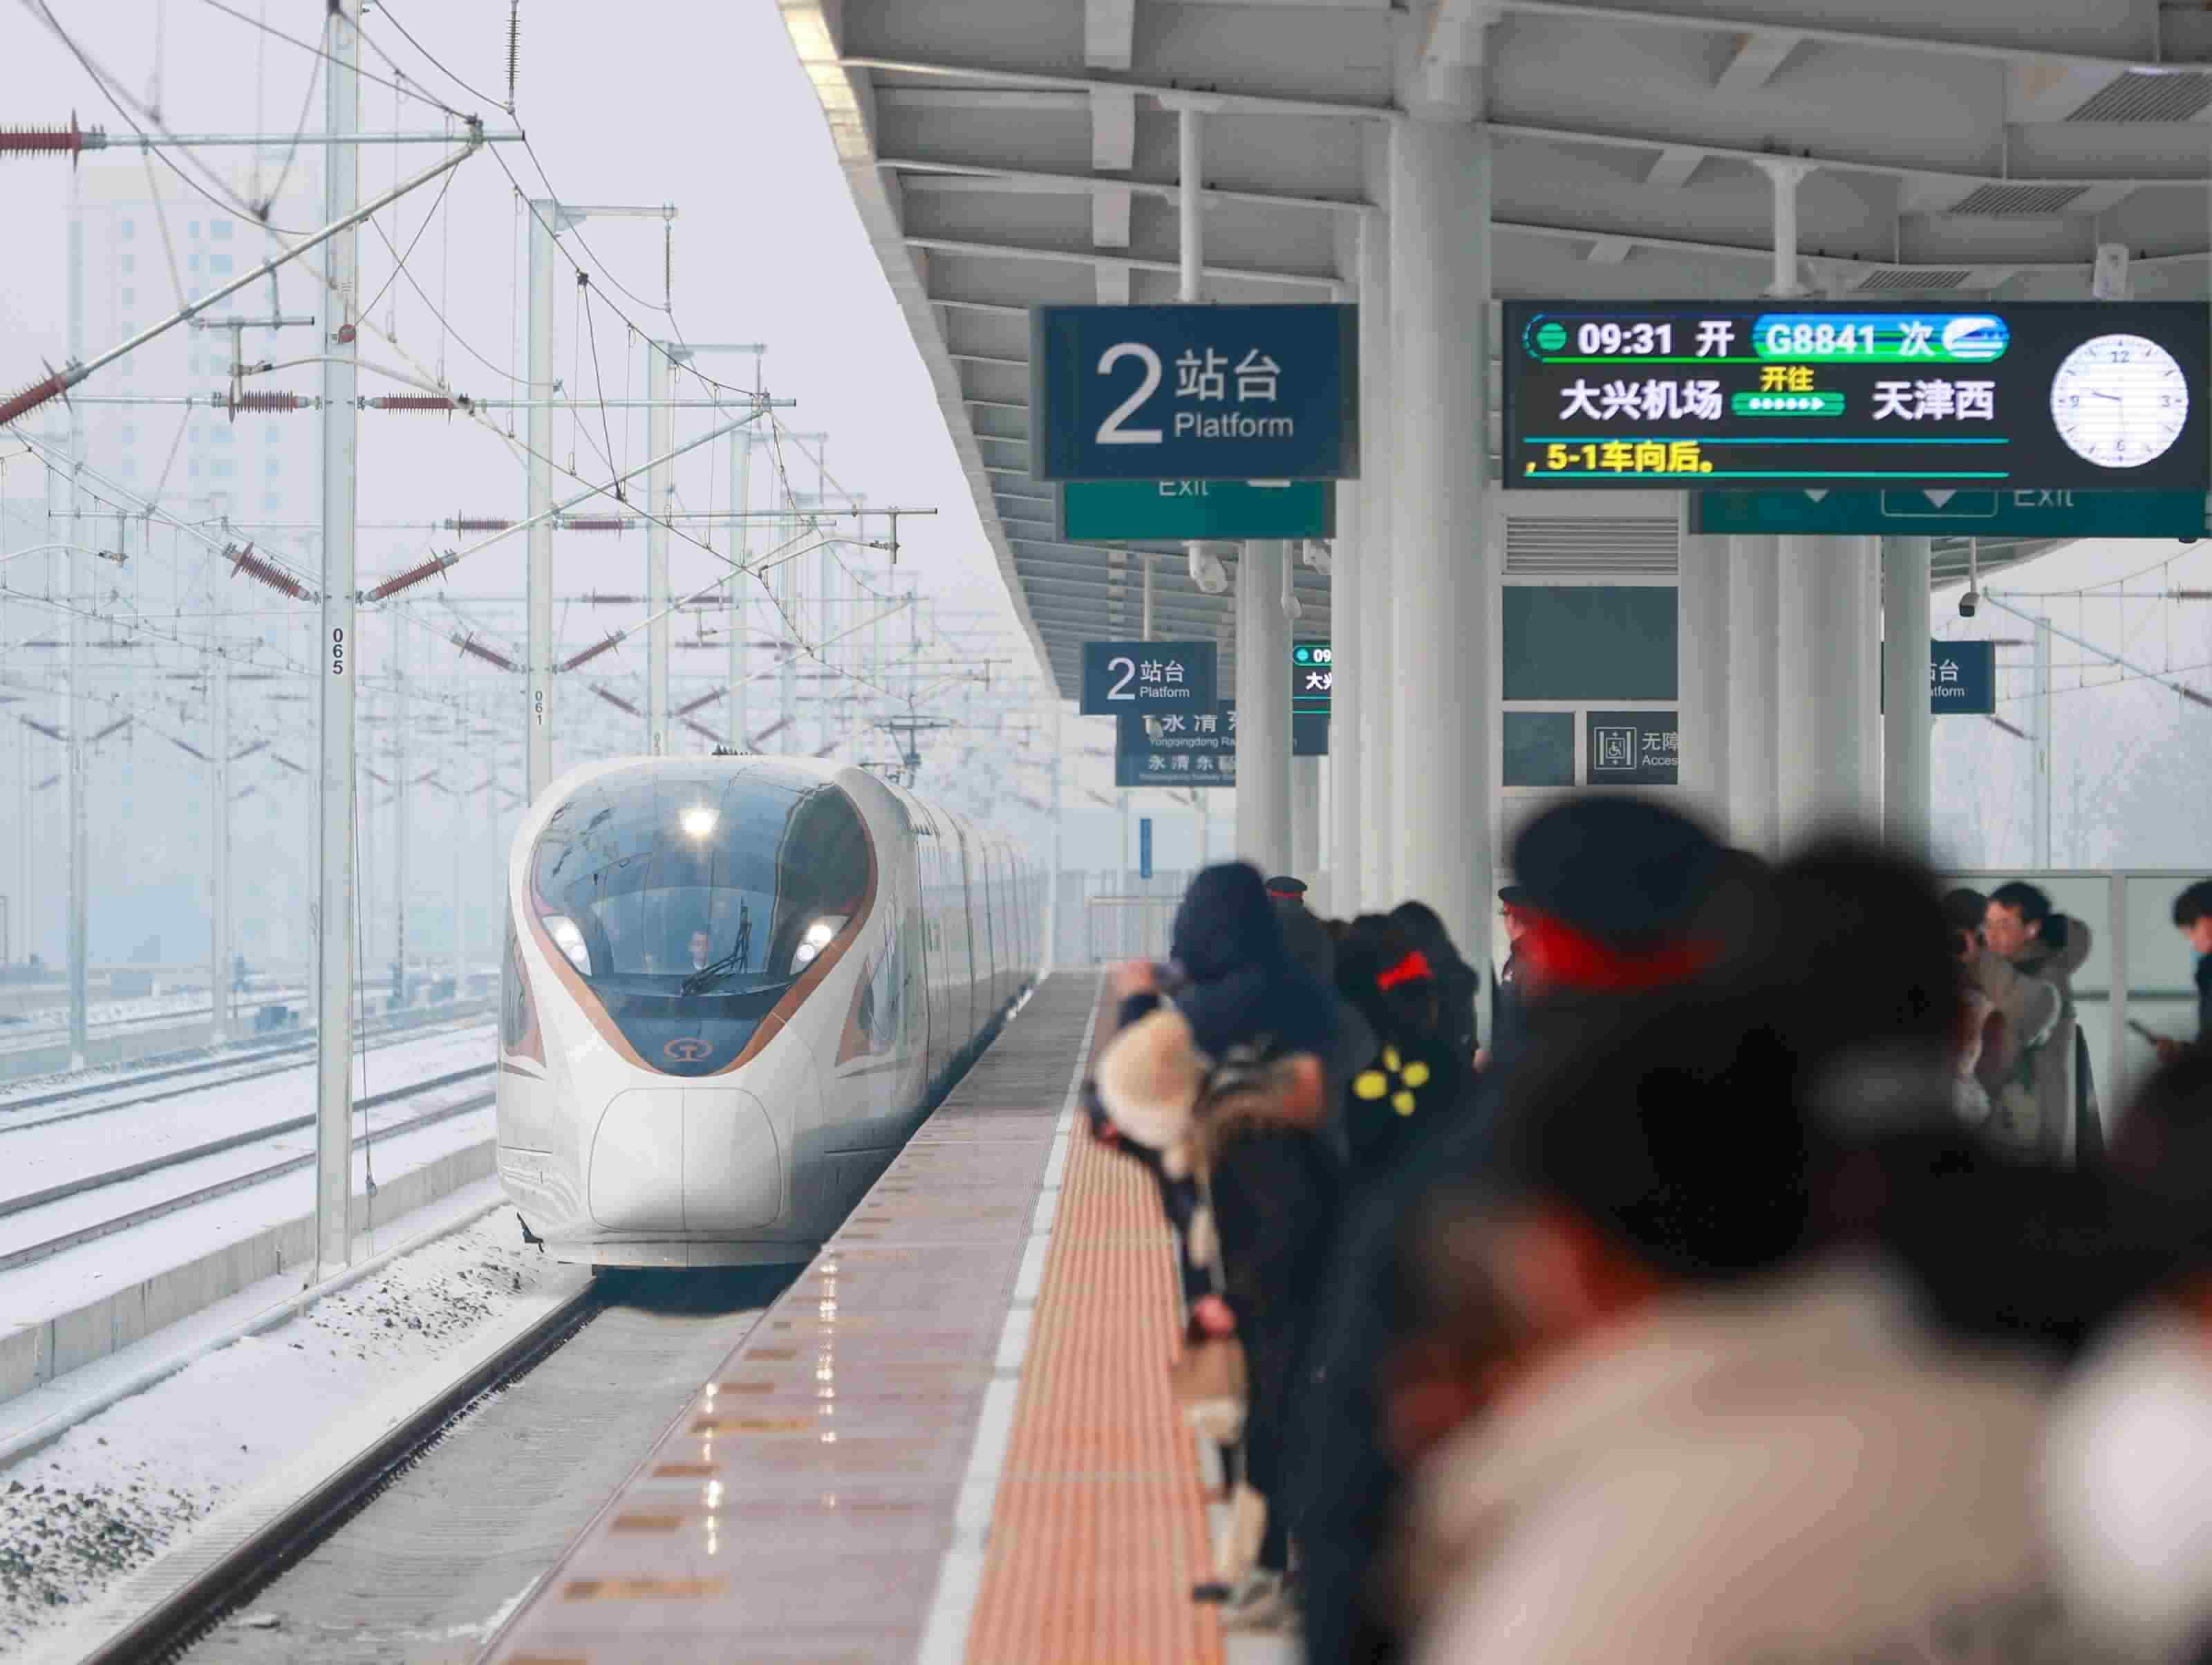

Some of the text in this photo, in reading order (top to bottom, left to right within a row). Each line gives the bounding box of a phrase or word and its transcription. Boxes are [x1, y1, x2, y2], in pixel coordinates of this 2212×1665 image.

[1578, 320, 1934, 357] 09:31 开 G8841 次
[2111, 351, 2130, 364] 12
[1096, 343, 1281, 444] 2 站台
[1760, 366, 1815, 391] 开往
[1559, 379, 1996, 420] 大兴机场 天津西
[1175, 413, 1294, 438] Platform
[332, 629, 344, 675] 065
[1106, 658, 1185, 700] 2 站台
[1140, 687, 1190, 698] Platform
[534, 691, 543, 725] 061
